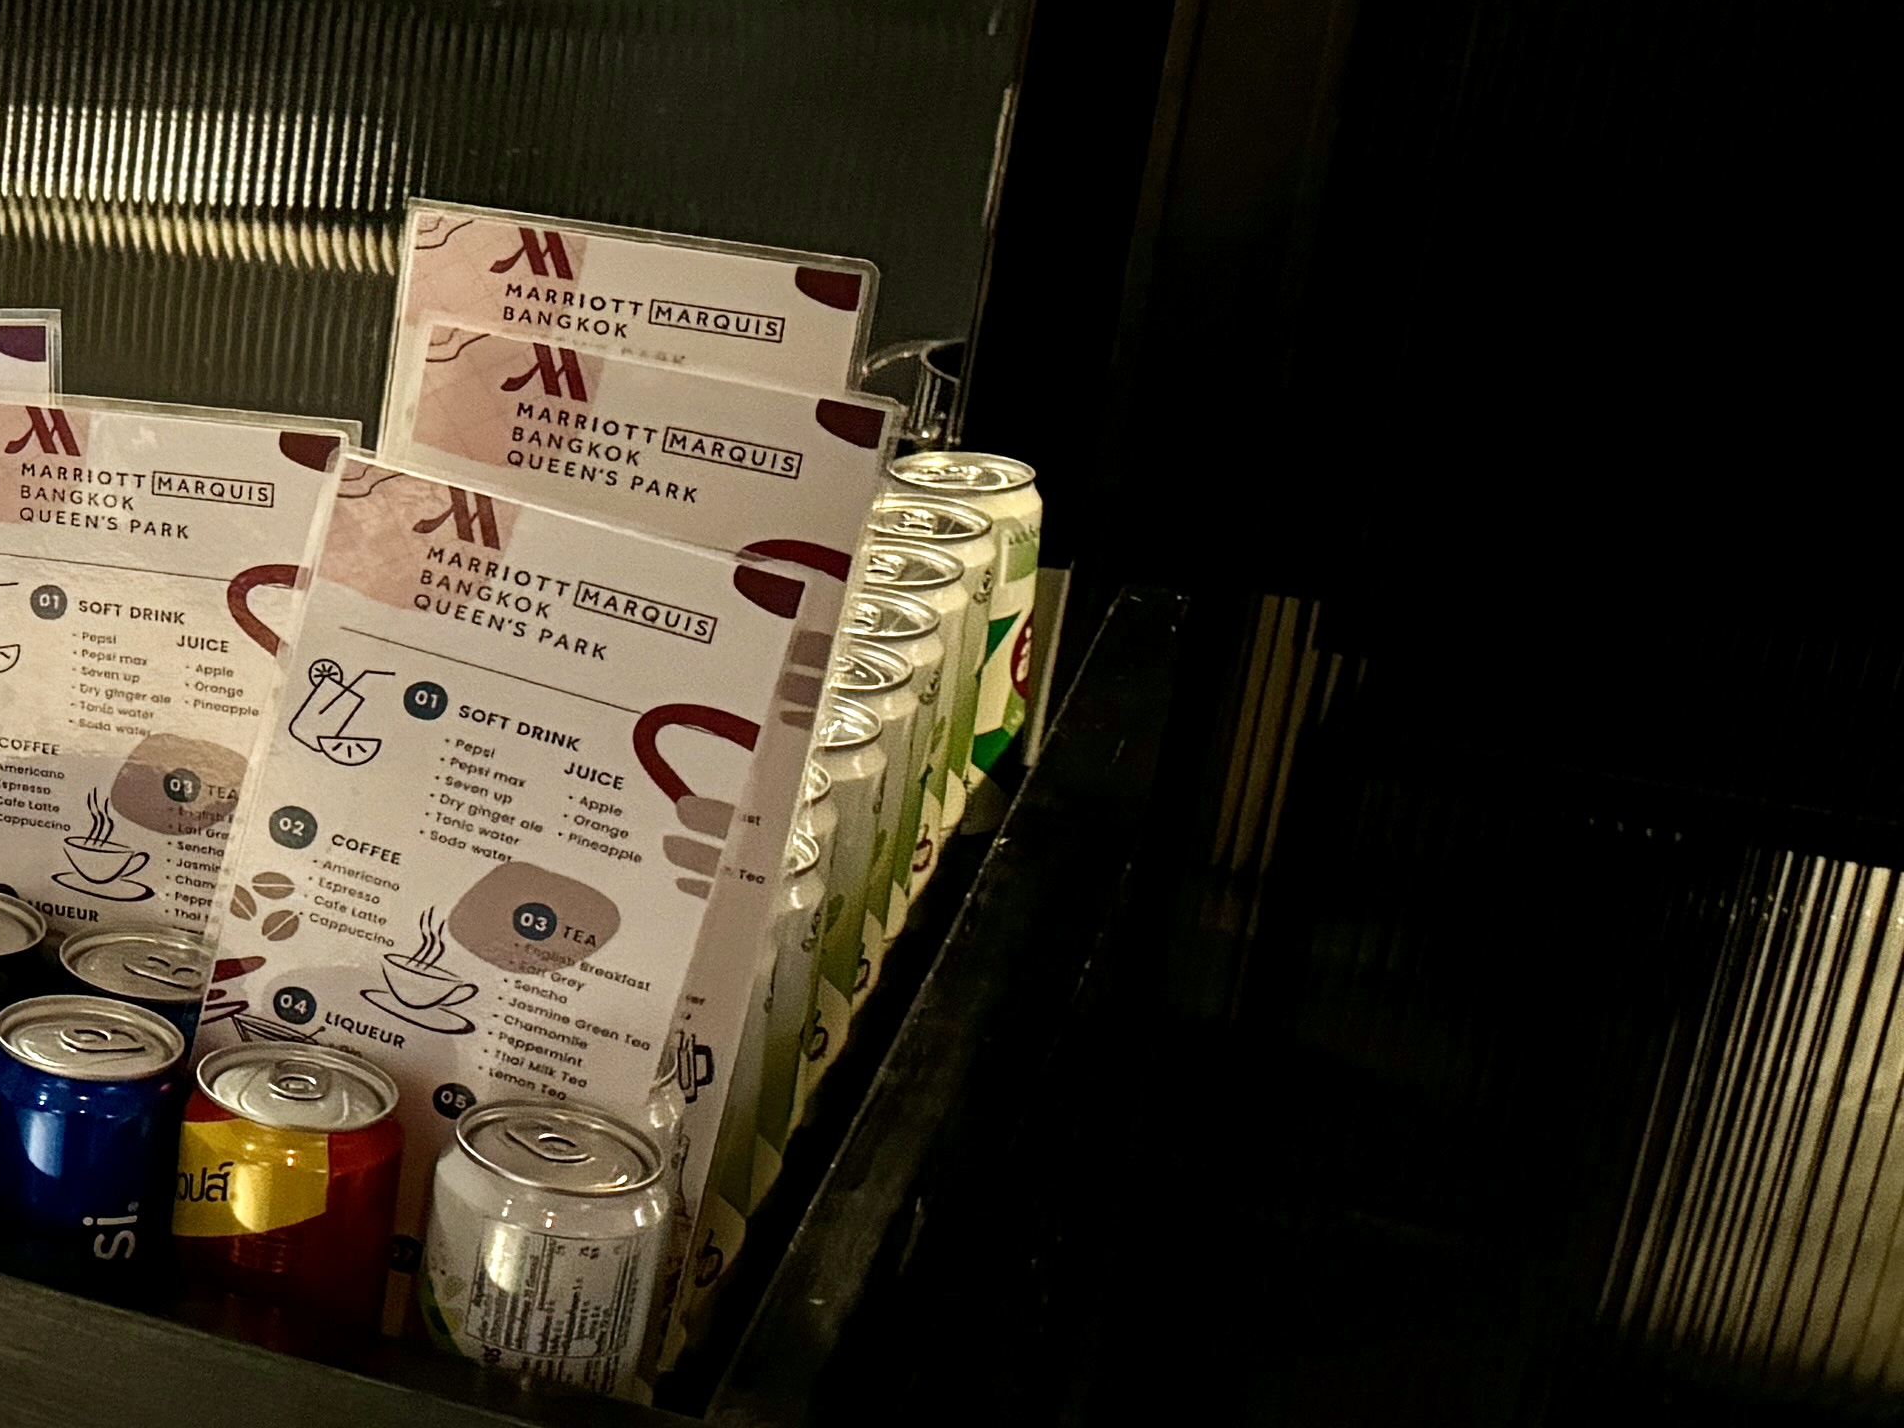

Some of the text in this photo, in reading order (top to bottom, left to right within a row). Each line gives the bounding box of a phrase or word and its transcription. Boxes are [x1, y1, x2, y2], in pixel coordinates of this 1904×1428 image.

[503, 307, 628, 339] BANGKOK
[505, 283, 779, 337] MARRIOTT MARQUIS
[512, 427, 640, 466] BANGKOK
[517, 403, 796, 472] MARRIOTT MARQUIS
[22, 463, 269, 502] MARRIOTT MARQUIS
[507, 451, 698, 504] QUEEN'S PARK
[21, 485, 134, 511] BANGKOK
[20, 508, 190, 539] QUEEN'S PARK
[420, 570, 551, 618] BANGKOK
[428, 546, 710, 637] MARRIOTT MARQUIS
[40, 594, 185, 625] 01 SOFT DRINK
[82, 632, 117, 646] Pepsi
[414, 594, 608, 661] QUEEN'S PARK
[82, 649, 147, 666] Pepsi max
[176, 635, 229, 653] JUICE
[81, 666, 141, 684] Seven up
[195, 664, 234, 678] Apple
[80, 684, 171, 704] Dry ginger ale
[194, 681, 244, 697] Orange
[118, 707, 155, 719] water
[193, 699, 259, 717] Pineapple
[415, 690, 581, 752] 01 SOFT DRINK
[455, 739, 495, 758] Pepsi
[451, 758, 526, 788] Pepsi max
[564, 762, 624, 790] JUICE
[170, 779, 238, 800] 03 TEA
[445, 776, 513, 805] Seven up
[29, 800, 60, 813] Latte
[439, 794, 543, 833] Dry ginger ale
[579, 796, 623, 818] Apple
[206, 828, 229, 840] Gre
[279, 817, 402, 865] 02 COFFEE
[436, 812, 523, 845] Tonic water
[574, 815, 629, 840] Orange
[177, 841, 224, 857] Sencha
[430, 830, 513, 863] Soda water
[569, 832, 642, 863] Pineapple
[318, 877, 380, 904] Espresso
[323, 861, 400, 891] Americano
[314, 896, 387, 925] Cafe Latte
[310, 912, 394, 947] Cappuccino
[521, 913, 597, 948] 03 TEA
[551, 972, 586, 991] Grey
[580, 960, 651, 991] Breakfast
[514, 980, 568, 1004] Sencha
[280, 994, 406, 1048] 04 LIQUEUR
[504, 1015, 588, 1049] Chamomile
[509, 998, 651, 1051] Jasmine Green Tea
[499, 1031, 583, 1067] Peppermint
[495, 1049, 587, 1088] Thai Milk Tea
[489, 1067, 567, 1101] Lemon Tea
[441, 1091, 467, 1108] 05
